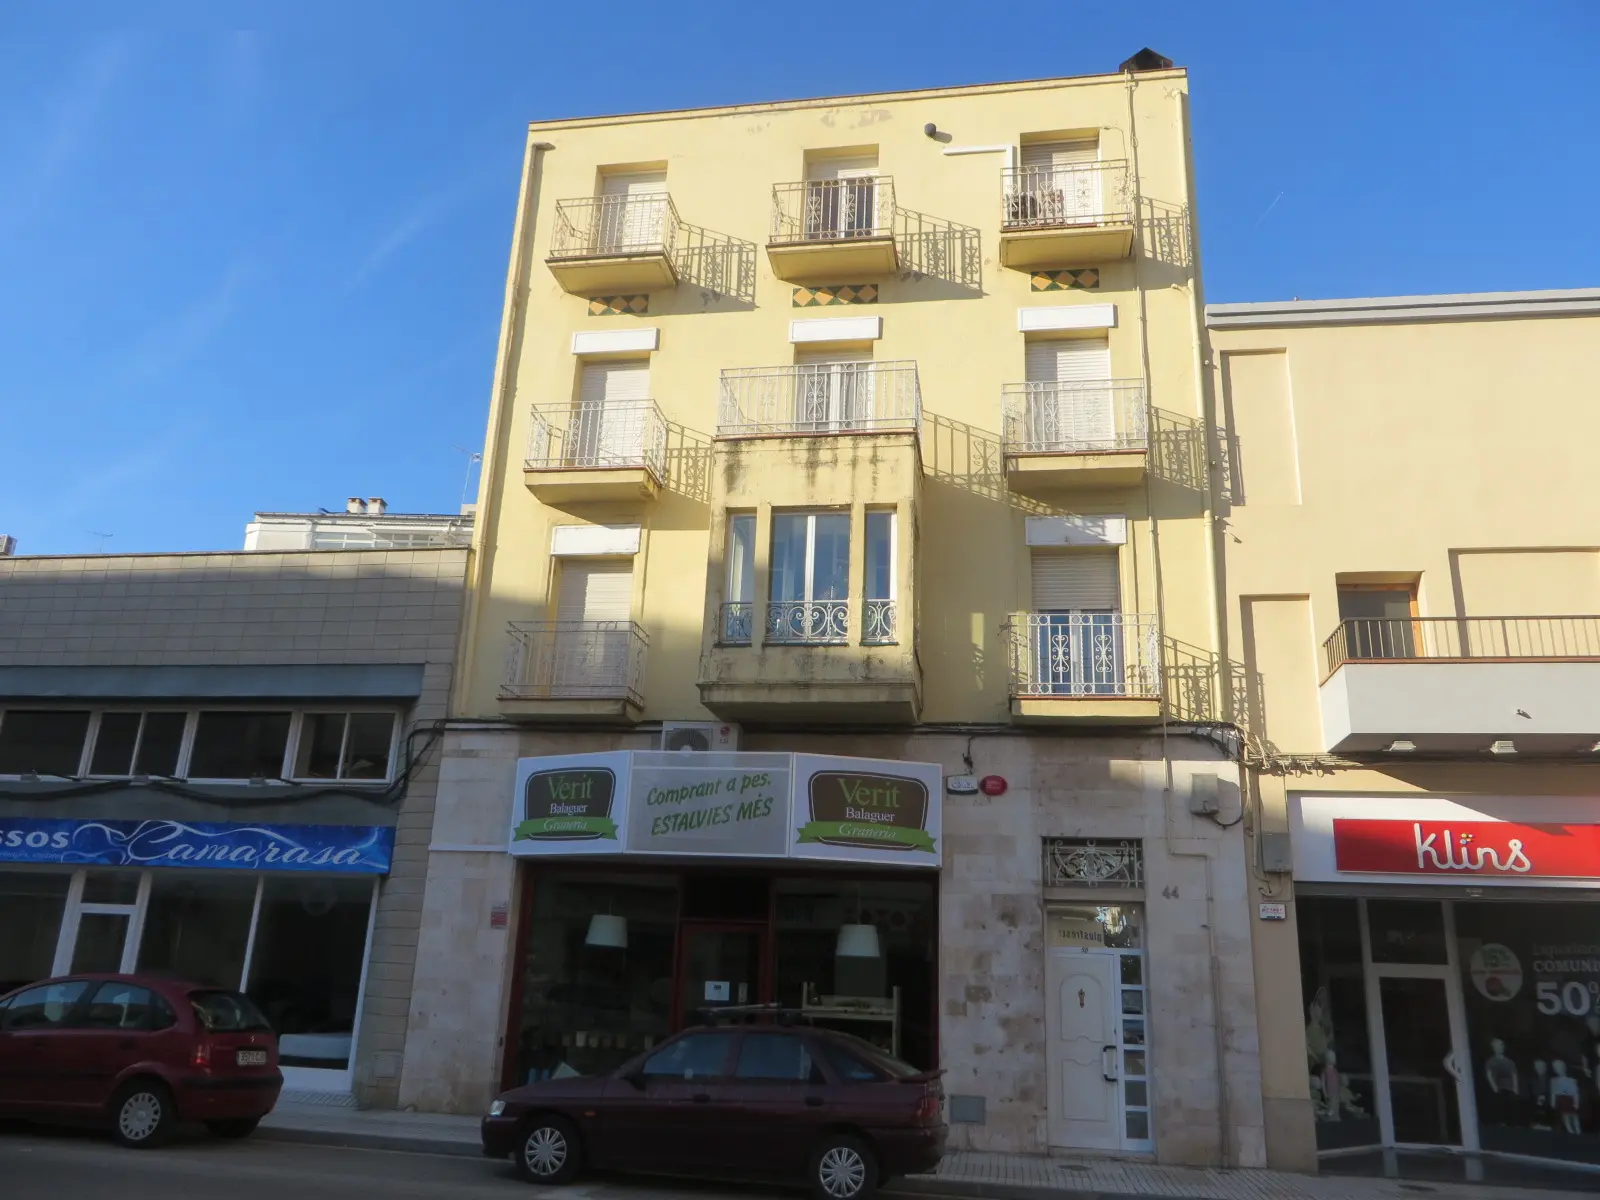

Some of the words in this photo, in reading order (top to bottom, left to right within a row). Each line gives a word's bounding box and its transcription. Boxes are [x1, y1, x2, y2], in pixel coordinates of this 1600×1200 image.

[548, 774, 594, 800] Verit
[646, 777, 722, 806] Comprant
[726, 777, 737, 792] a
[740, 773, 772, 794] pes.
[837, 777, 901, 808] Verit
[549, 802, 588, 816] Balaguer
[651, 804, 735, 836] ESTALVIES
[845, 806, 896, 823] Balaguer
[123, 821, 369, 868] Camarasa
[1162, 885, 1179, 899] 44
